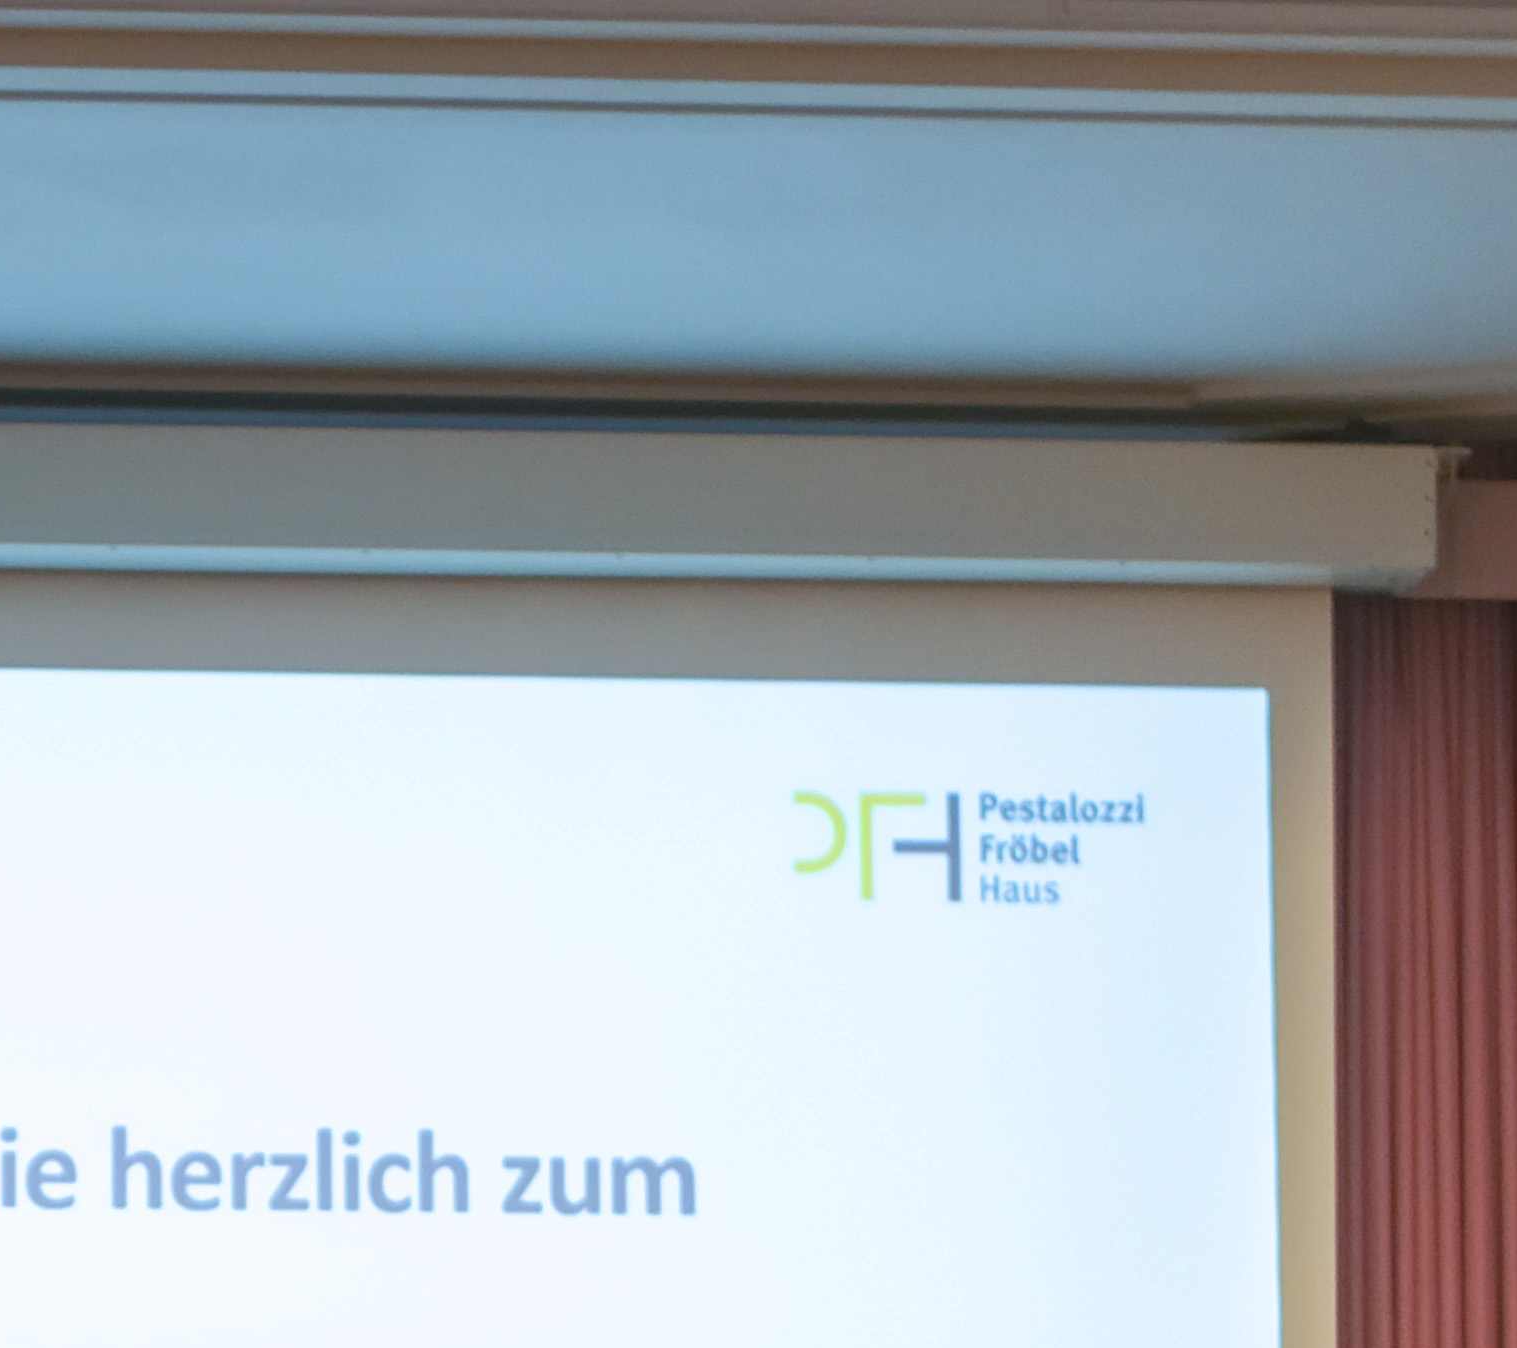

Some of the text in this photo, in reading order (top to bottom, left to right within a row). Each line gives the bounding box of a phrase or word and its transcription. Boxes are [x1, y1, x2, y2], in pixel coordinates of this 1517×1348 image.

[979, 791, 1147, 825] Pestalozzi
[979, 833, 1081, 866] Fröbel
[979, 875, 1061, 906] Haus
[111, 1125, 470, 1213] herzlich
[502, 1156, 697, 1216] zum
